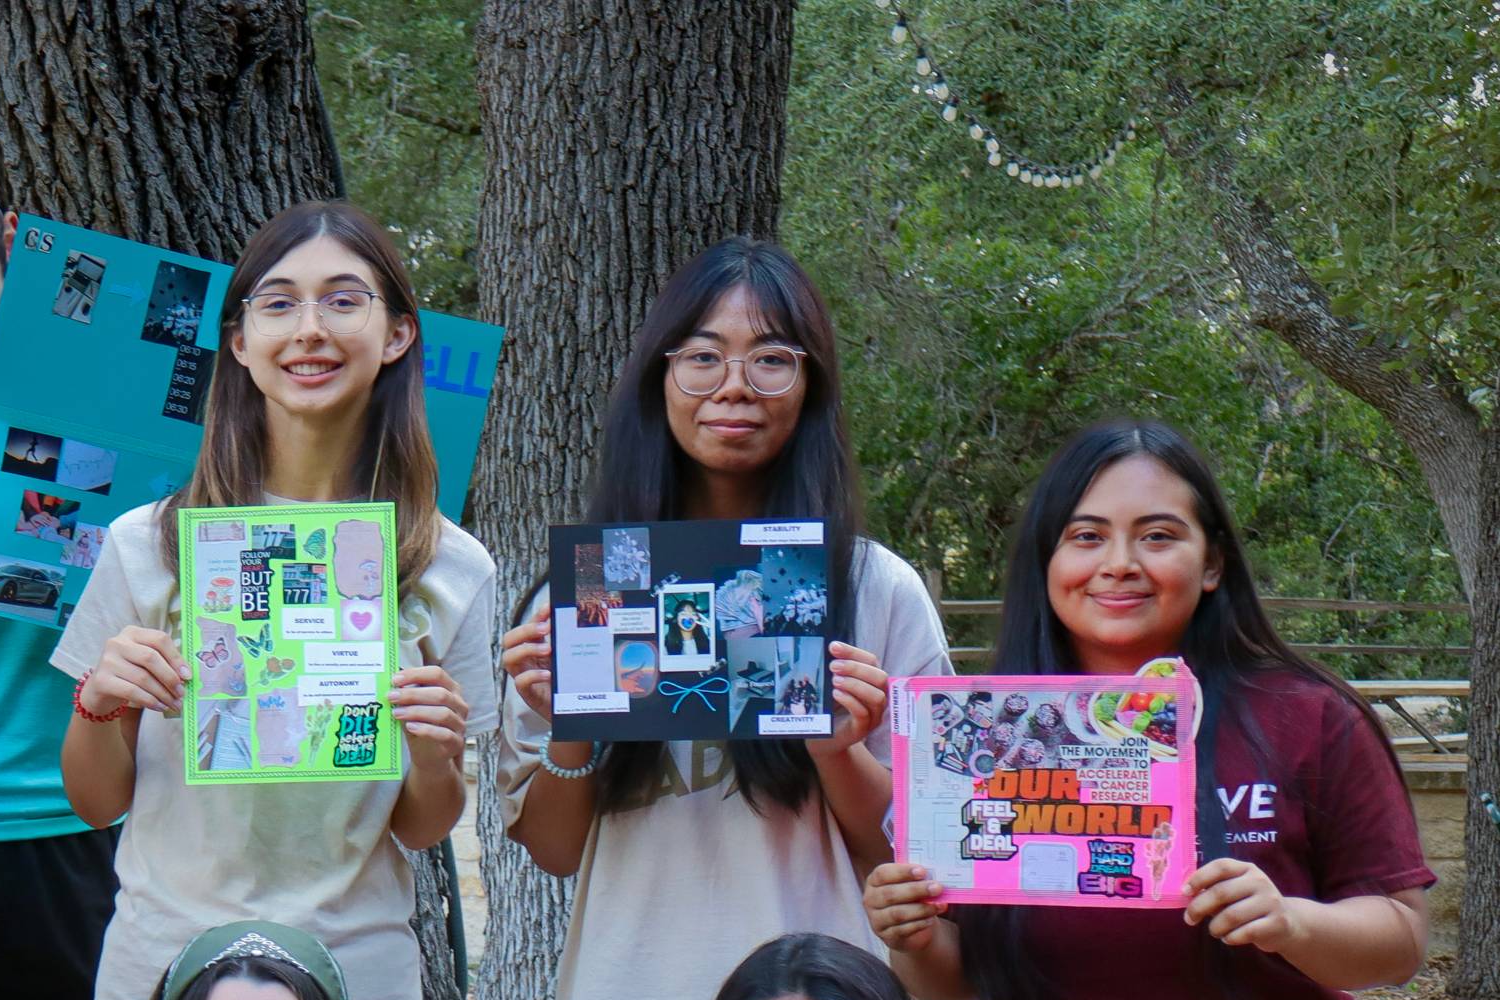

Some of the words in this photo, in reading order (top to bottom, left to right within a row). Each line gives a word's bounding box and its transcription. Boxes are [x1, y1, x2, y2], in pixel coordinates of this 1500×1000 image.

[241, 551, 271, 559] FOLLOW
[241, 558, 262, 566] YOUR
[241, 571, 274, 586] BUT
[242, 592, 269, 611] BE
[344, 703, 381, 717] DON'T
[340, 715, 377, 737] DIE
[1120, 737, 1149, 747] JOIN
[1061, 746, 1080, 756] THE
[1084, 747, 1149, 757] MOVEMENT
[1134, 759, 1148, 769] TO
[1078, 769, 1149, 780] ACCELERATE
[988, 768, 1080, 800] OUR
[1100, 781, 1149, 790] CANCER
[1091, 791, 1149, 801] RESEARCH
[970, 800, 1017, 818] FEEL
[1011, 803, 1173, 838] WORLD
[968, 833, 1019, 852] DEAL
[1089, 840, 1134, 855] WORK
[1091, 853, 1134, 866] HARD
[1079, 873, 1142, 896] BIG
